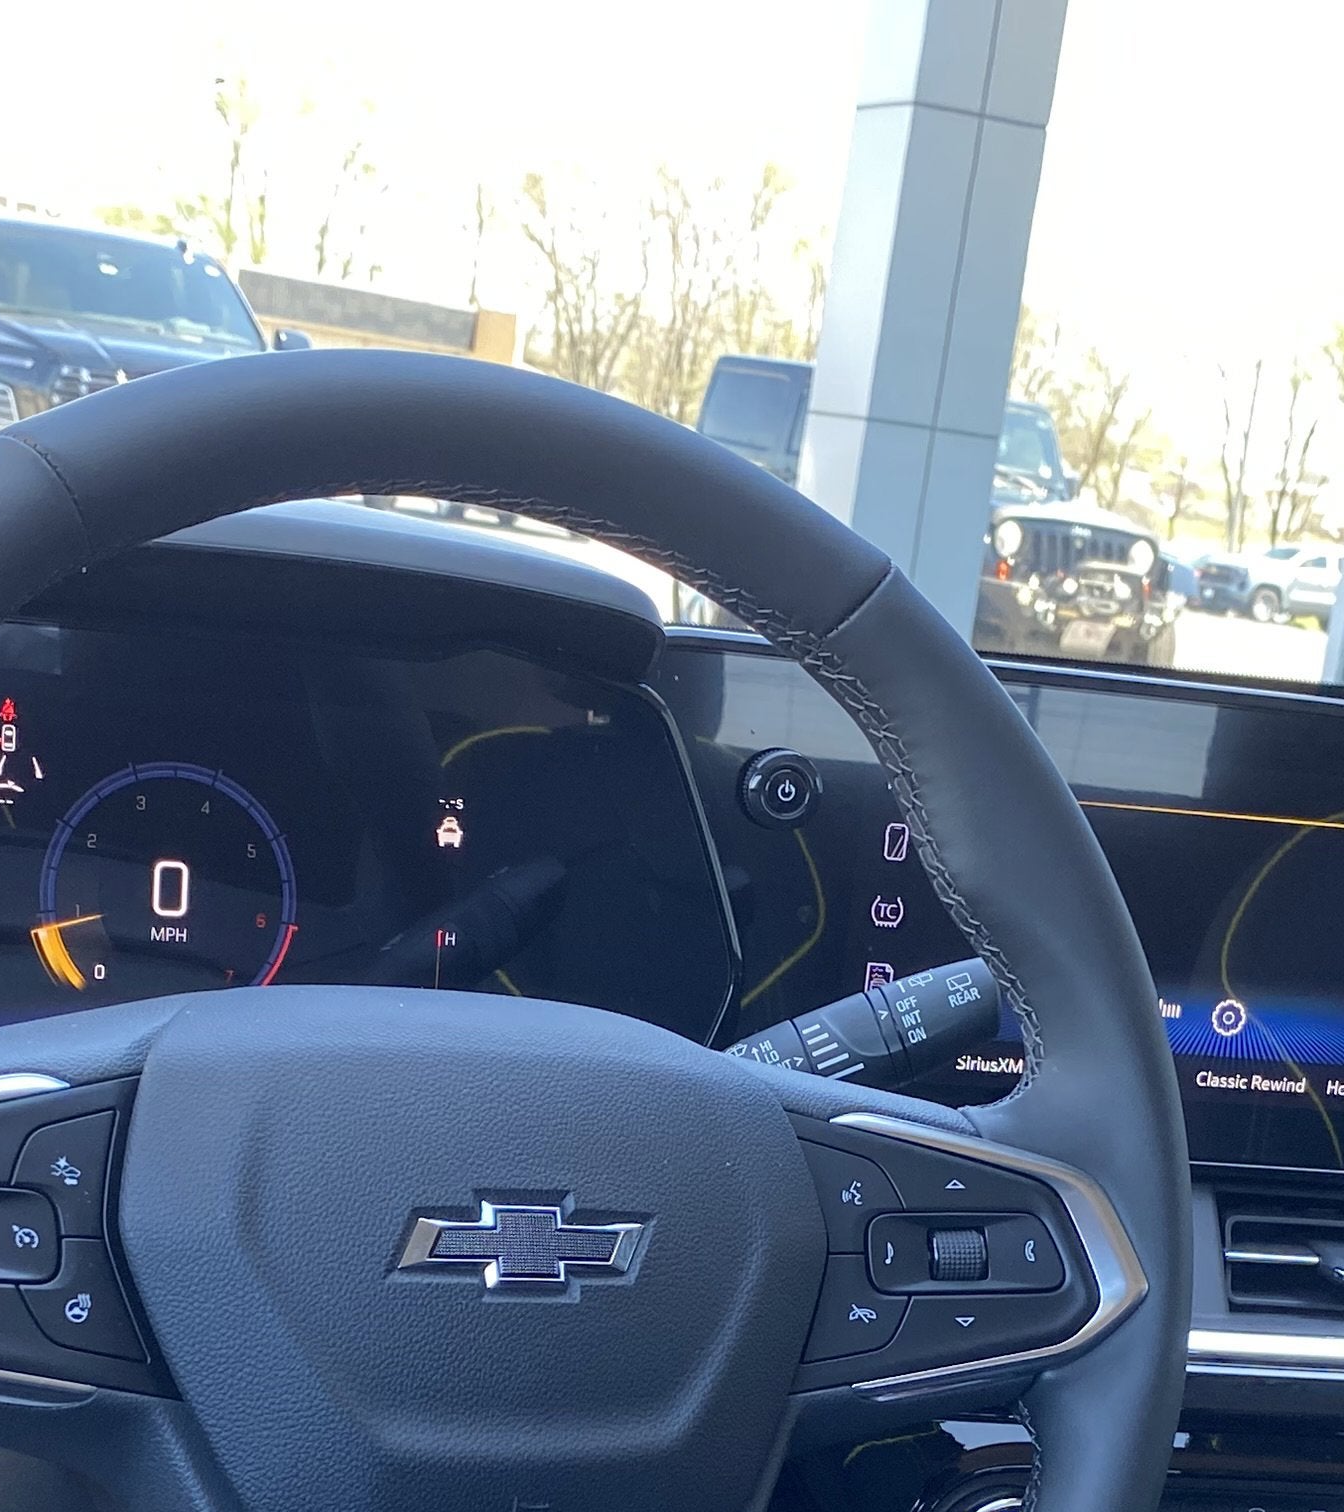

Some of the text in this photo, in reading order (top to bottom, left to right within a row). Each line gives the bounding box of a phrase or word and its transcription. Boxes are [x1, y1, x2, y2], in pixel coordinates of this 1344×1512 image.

[136, 796, 146, 811] 3
[200, 800, 210, 814] 4
[87, 833, 97, 848] 2
[247, 843, 256, 858] 5
[152, 860, 189, 918] 0
[150, 926, 187, 943] MPH
[444, 932, 456, 946] H
[94, 964, 105, 980] 0
[896, 995, 917, 1013] OFF
[947, 987, 981, 1008] REAR
[901, 1009, 922, 1028] INT
[907, 1026, 927, 1044] ON
[759, 1040, 773, 1053] HI
[763, 1050, 780, 1064] LO
[955, 1055, 1024, 1074] SiriusXM
[1196, 1070, 1306, 1094] Classic Rewind
